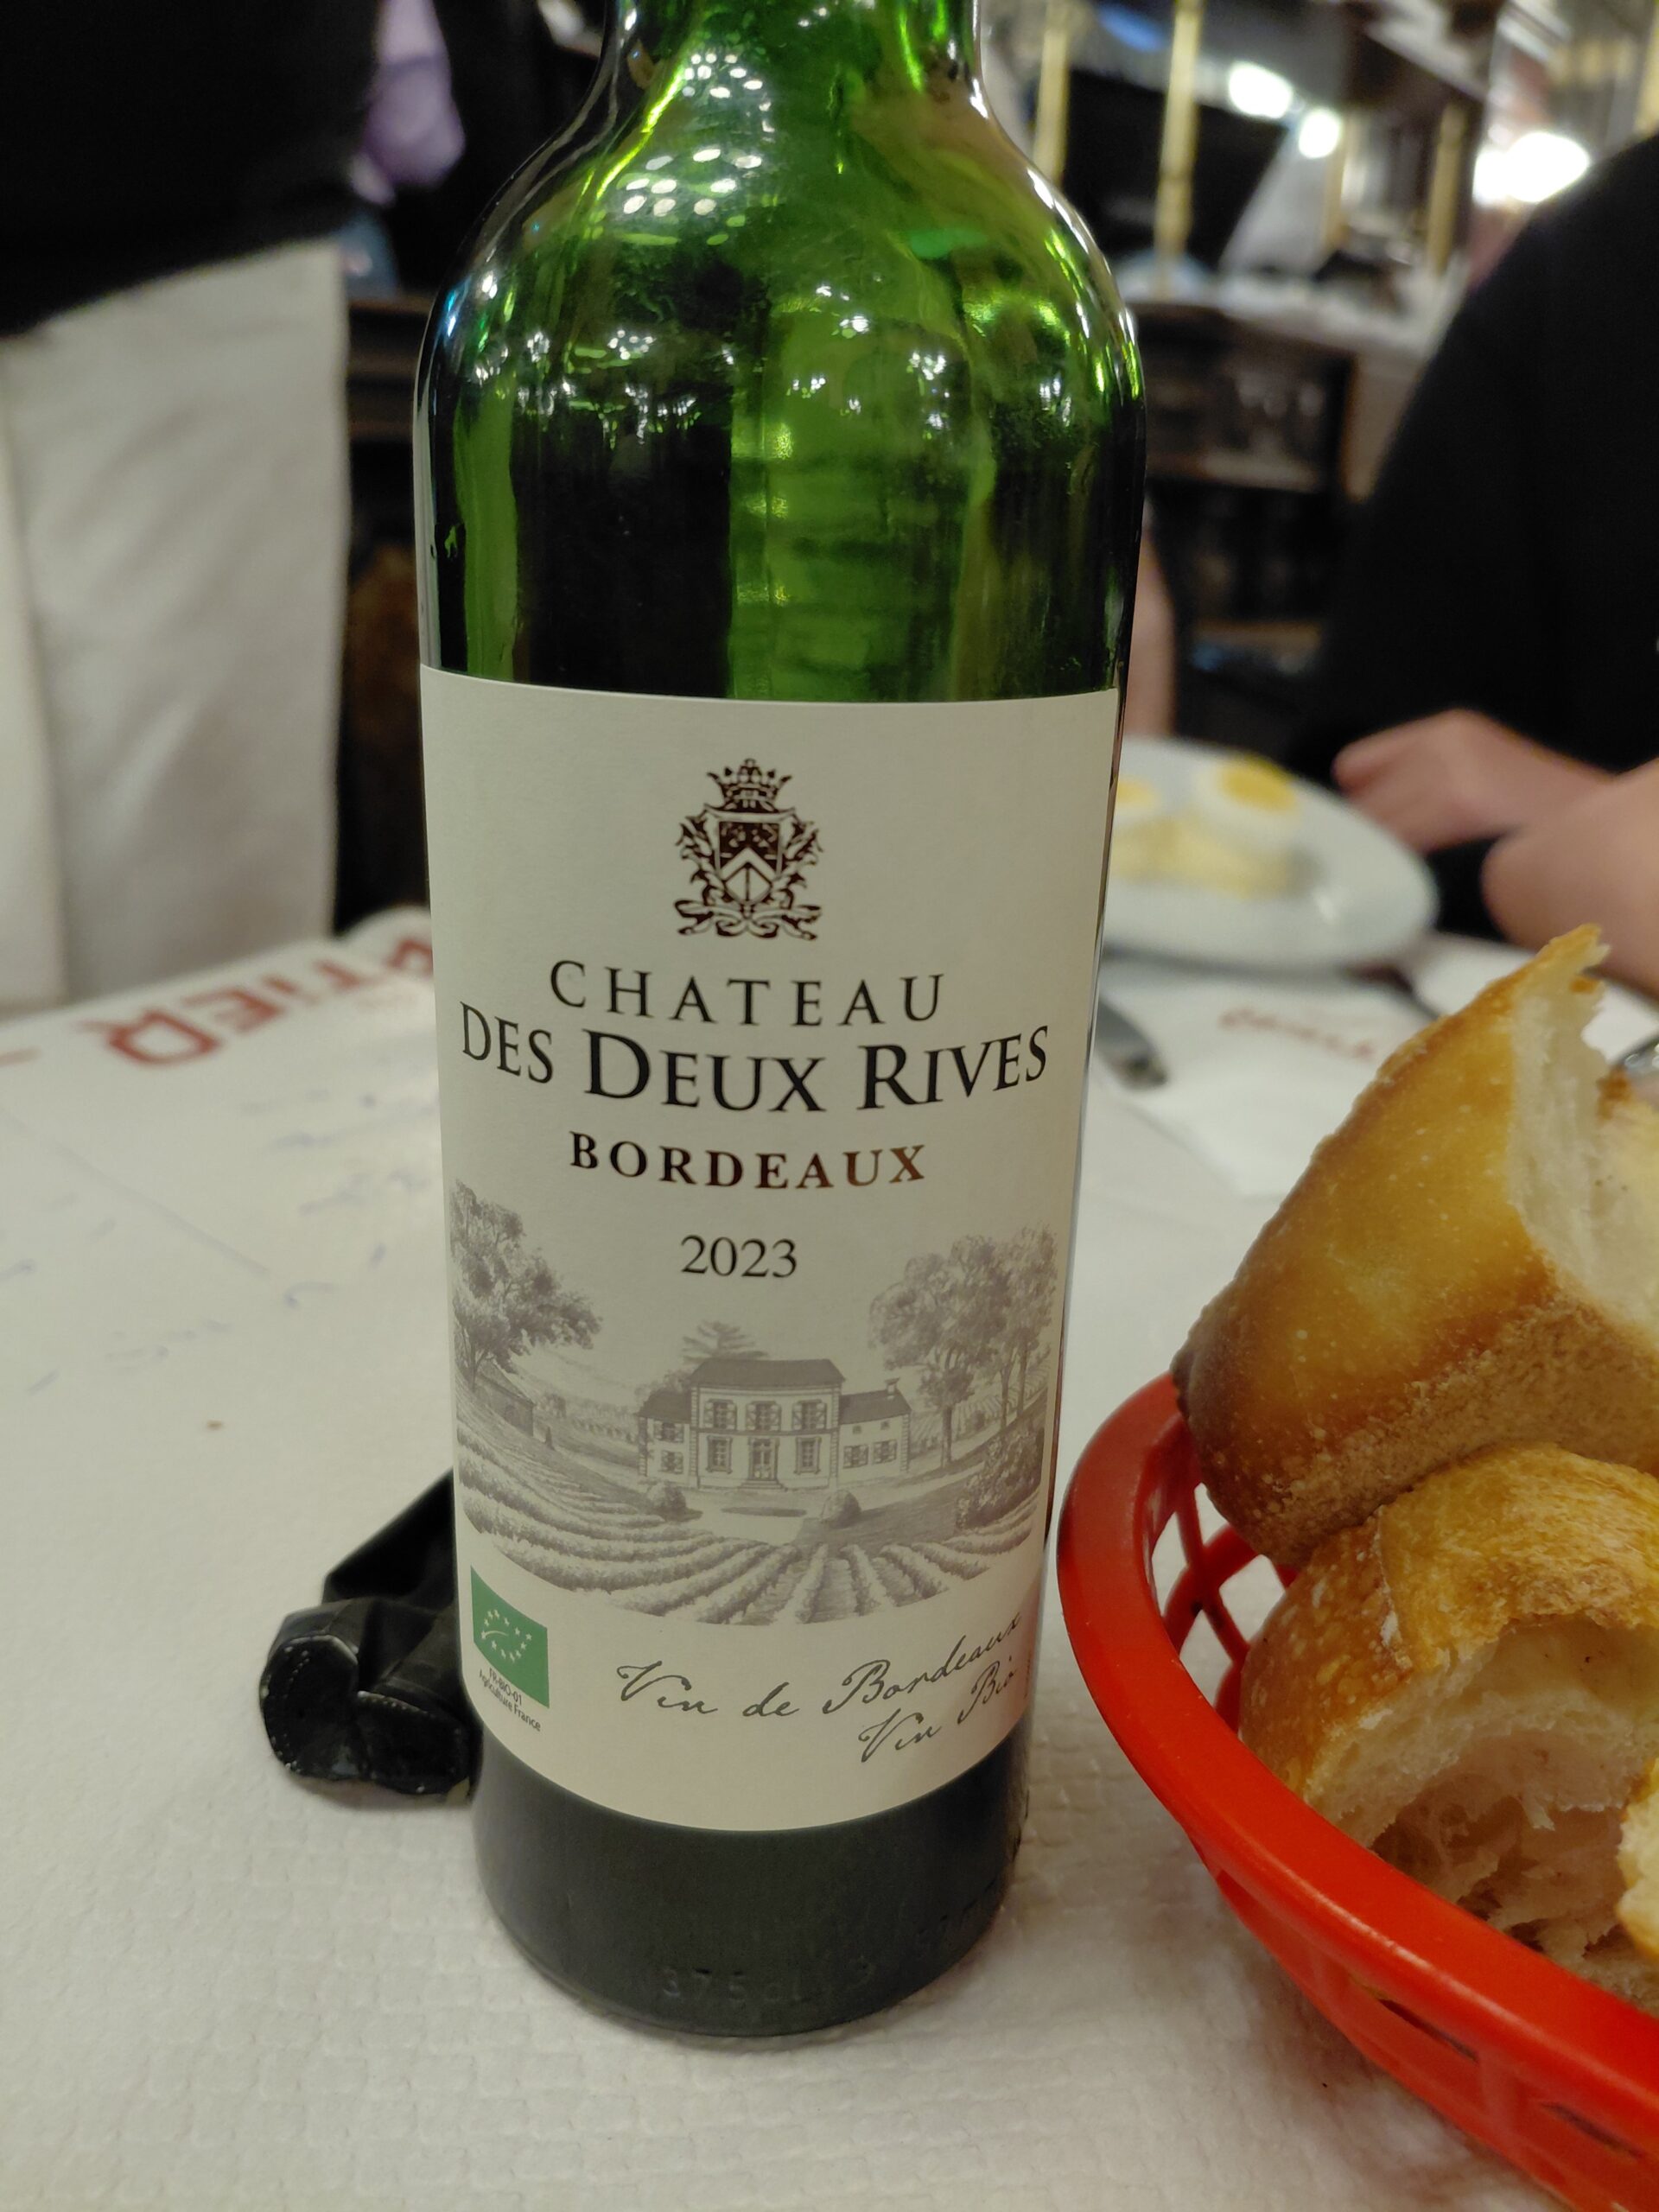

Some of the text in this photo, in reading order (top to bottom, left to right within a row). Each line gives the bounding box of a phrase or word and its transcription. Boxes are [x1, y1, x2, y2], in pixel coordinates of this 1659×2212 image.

[550, 960, 944, 1027] CHATEAU
[461, 1001, 1049, 1114] DES DEUX RIVES
[569, 1131, 926, 1189] BORDEAUX
[681, 1235, 797, 1277] 2023
[617, 1660, 718, 1714] Vin
[742, 1681, 800, 1718] de
[823, 1611, 1021, 1715] Bordeaux
[514, 1704, 541, 1732] France
[858, 1708, 942, 1763] Vin
[957, 1654, 1016, 1725] Bio
